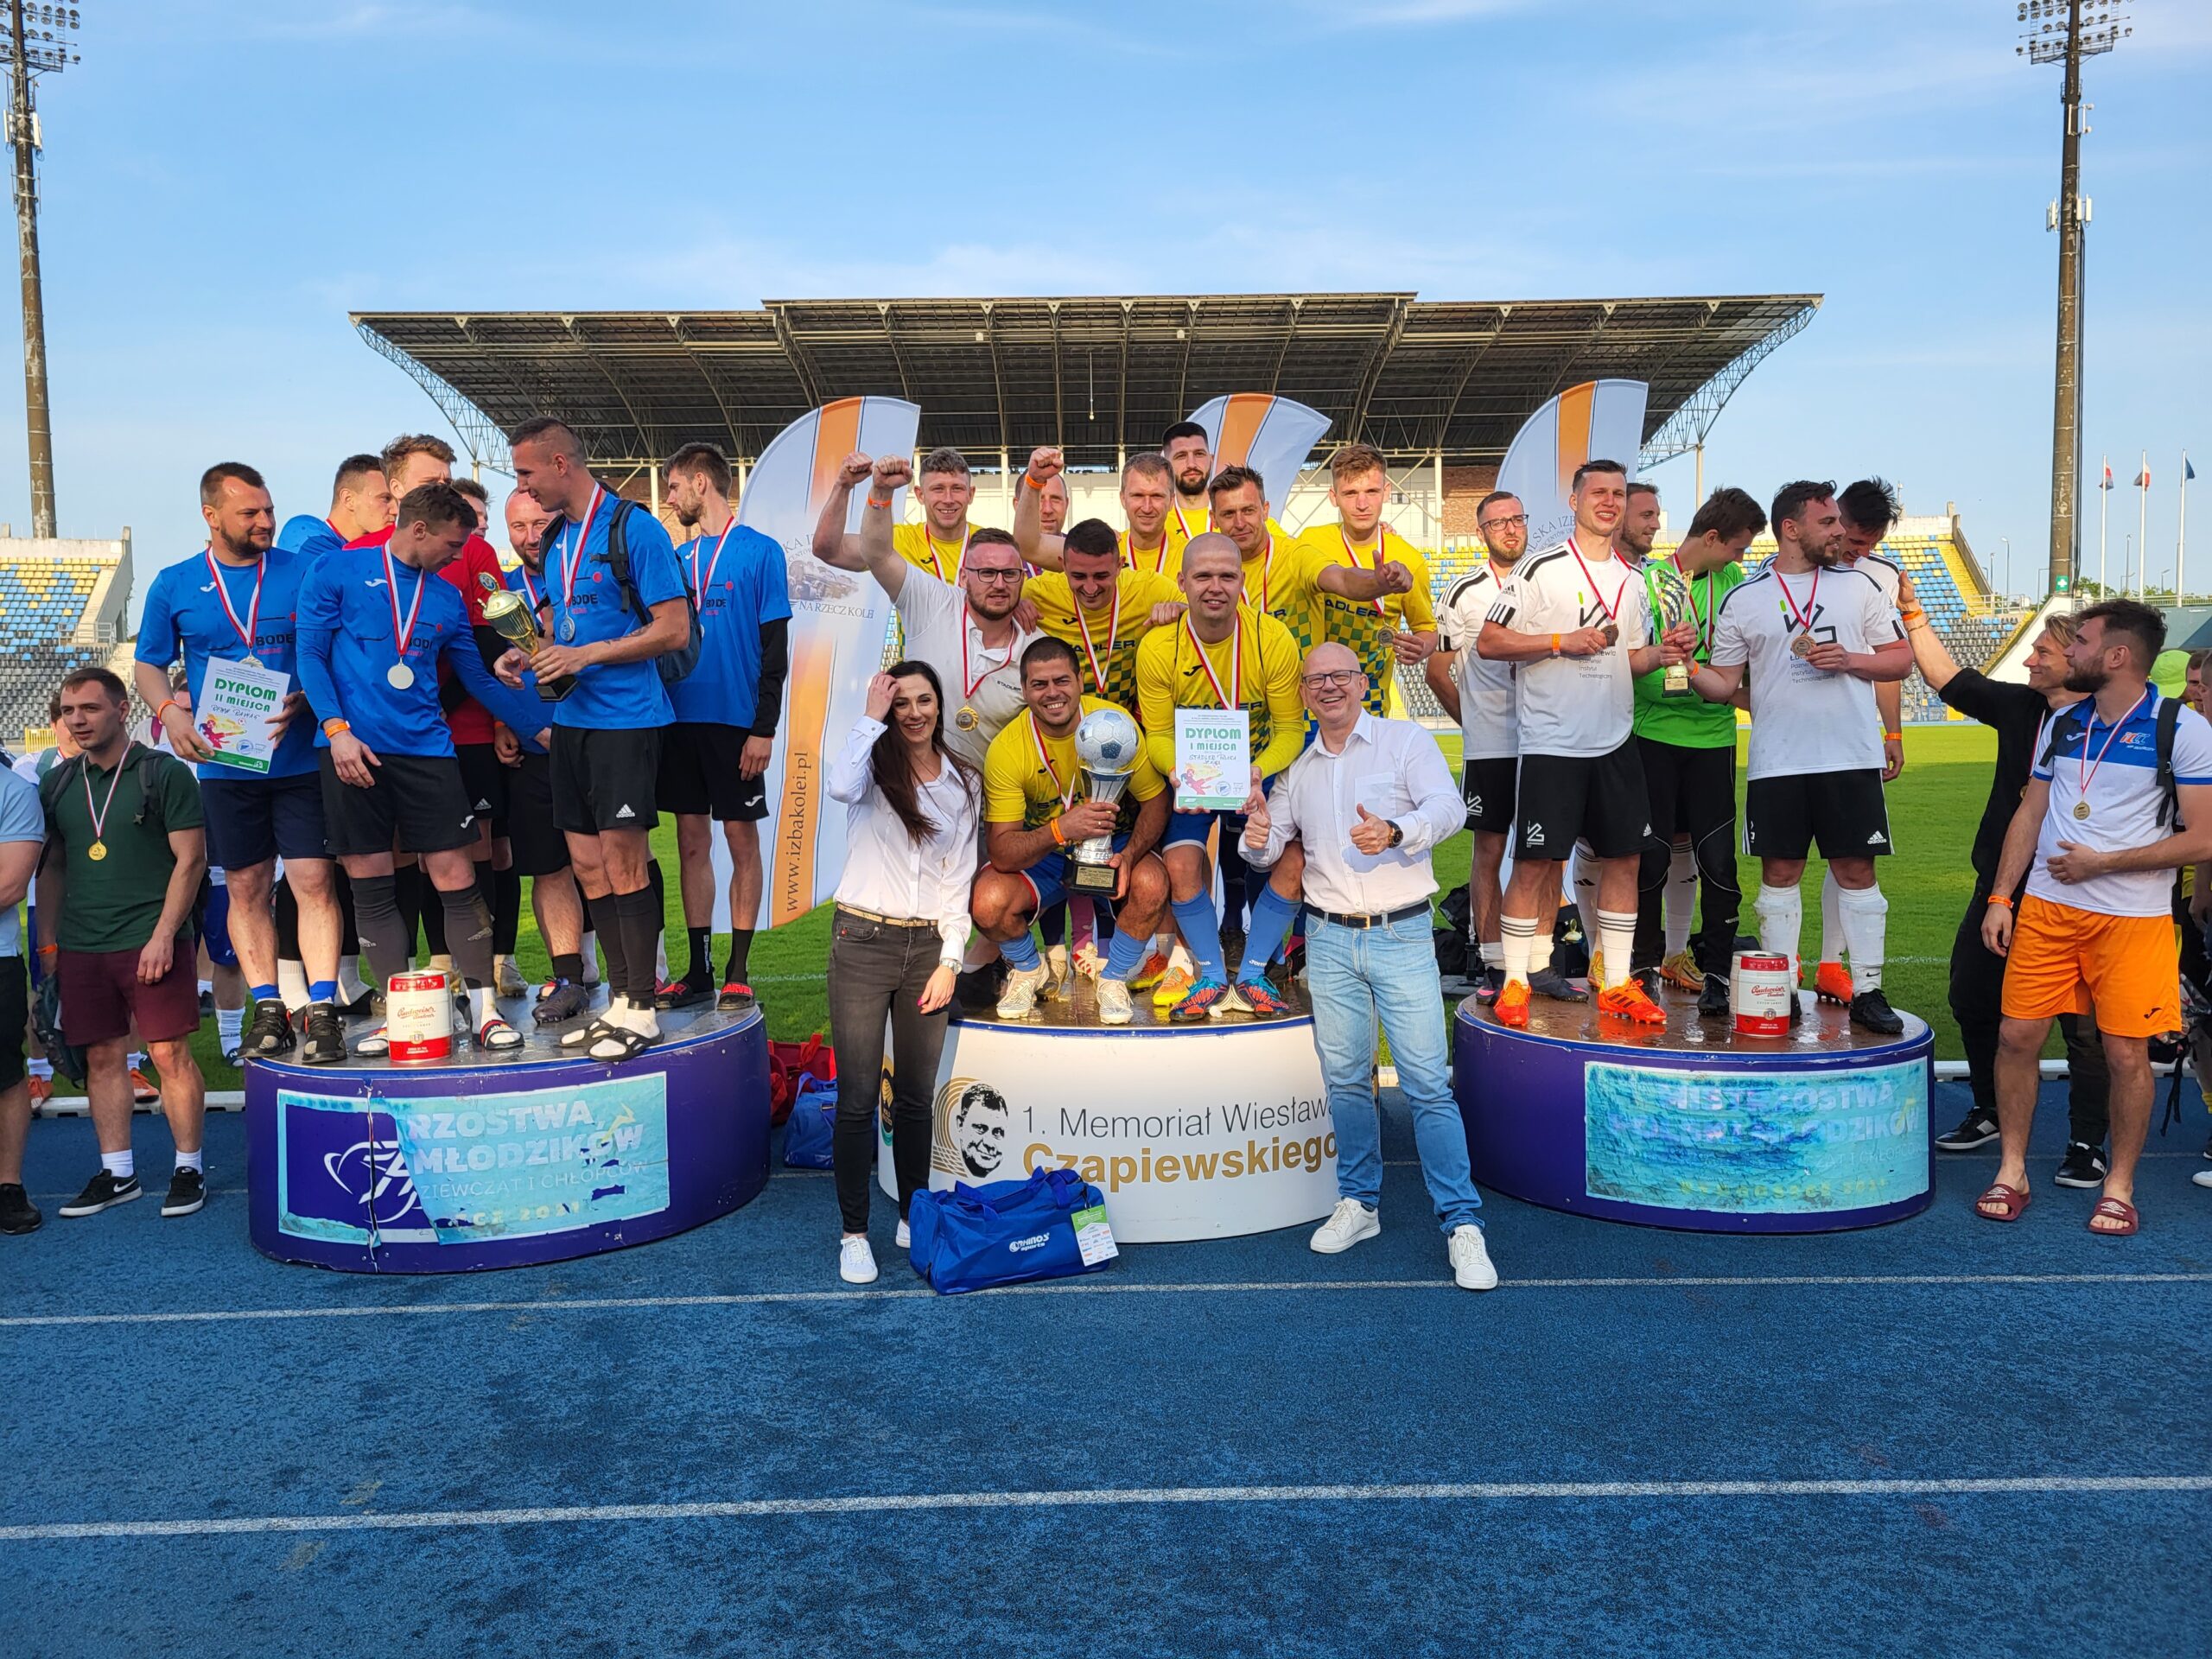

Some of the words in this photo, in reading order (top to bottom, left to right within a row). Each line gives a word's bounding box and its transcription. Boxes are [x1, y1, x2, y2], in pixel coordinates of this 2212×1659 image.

[798, 601, 813, 612] NA
[815, 603, 847, 615] RZECZ
[1325, 599, 1380, 617] ADLER
[256, 633, 295, 646] BODE
[214, 677, 277, 702] DYPLOM
[226, 696, 270, 713] MIEJSCA
[1185, 728, 1242, 740] DYPLOM
[1197, 742, 1236, 751] MIEJSCA
[785, 752, 811, 912] www.izbakolei.pl
[409, 1099, 594, 1141] RZOSTWA
[1022, 1105, 1046, 1135] 1.
[1059, 1105, 1212, 1139] Memoriał
[421, 1178, 524, 1201] ZIEWCZĄT
